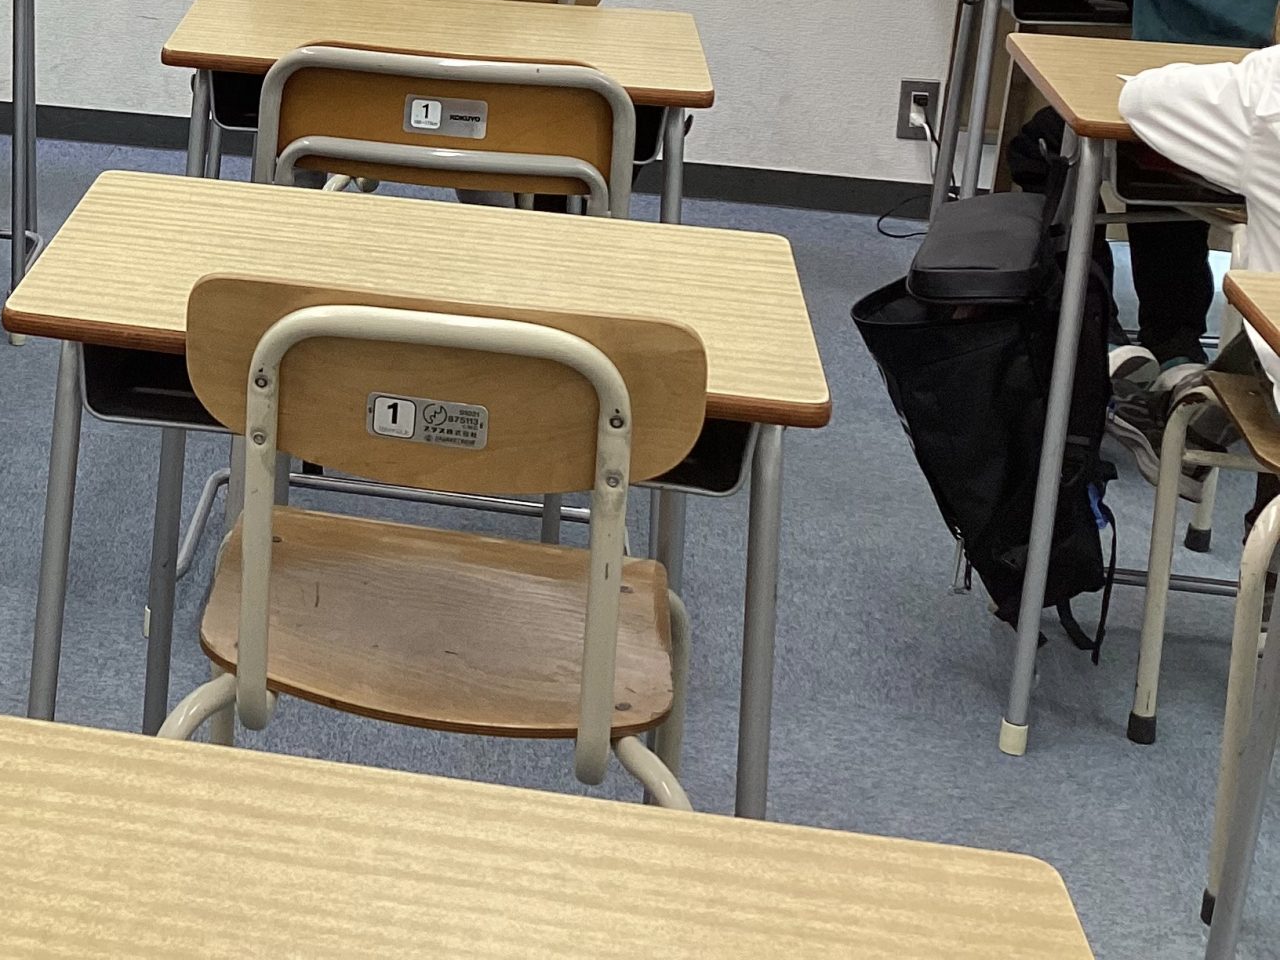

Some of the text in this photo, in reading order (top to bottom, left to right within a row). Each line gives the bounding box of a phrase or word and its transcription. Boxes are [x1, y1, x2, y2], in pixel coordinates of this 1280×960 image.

[422, 103, 430, 120] 1
[449, 114, 481, 123] KOKUYO
[387, 402, 399, 425] 1
